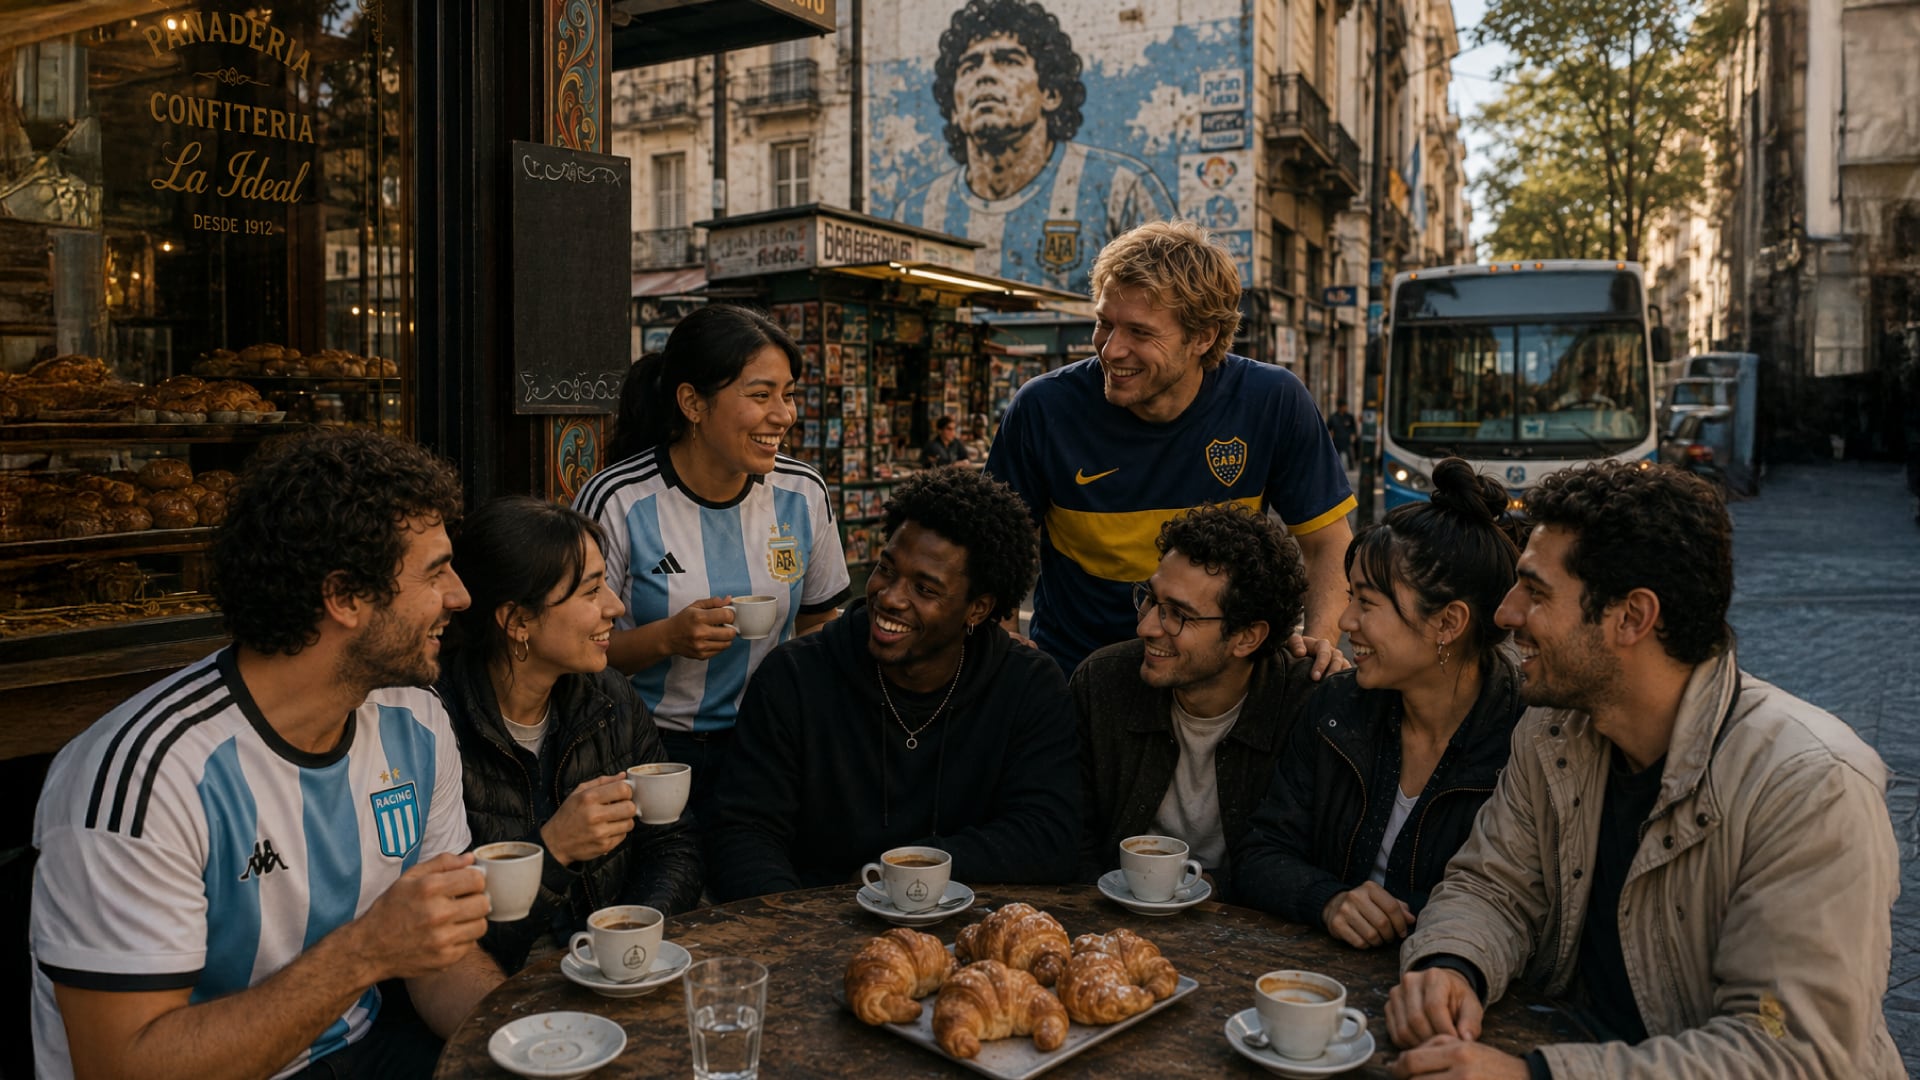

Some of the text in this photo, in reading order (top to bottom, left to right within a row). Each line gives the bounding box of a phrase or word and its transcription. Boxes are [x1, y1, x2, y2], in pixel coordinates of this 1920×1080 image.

[142, 11, 311, 81] PANADERIA
[150, 91, 314, 144] CONFITERIA
[151, 141, 310, 203] La Ideal
[193, 213, 273, 235] DESDE 1912
[1212, 453, 1243, 467] CABJ
[375, 789, 413, 809] RACING
